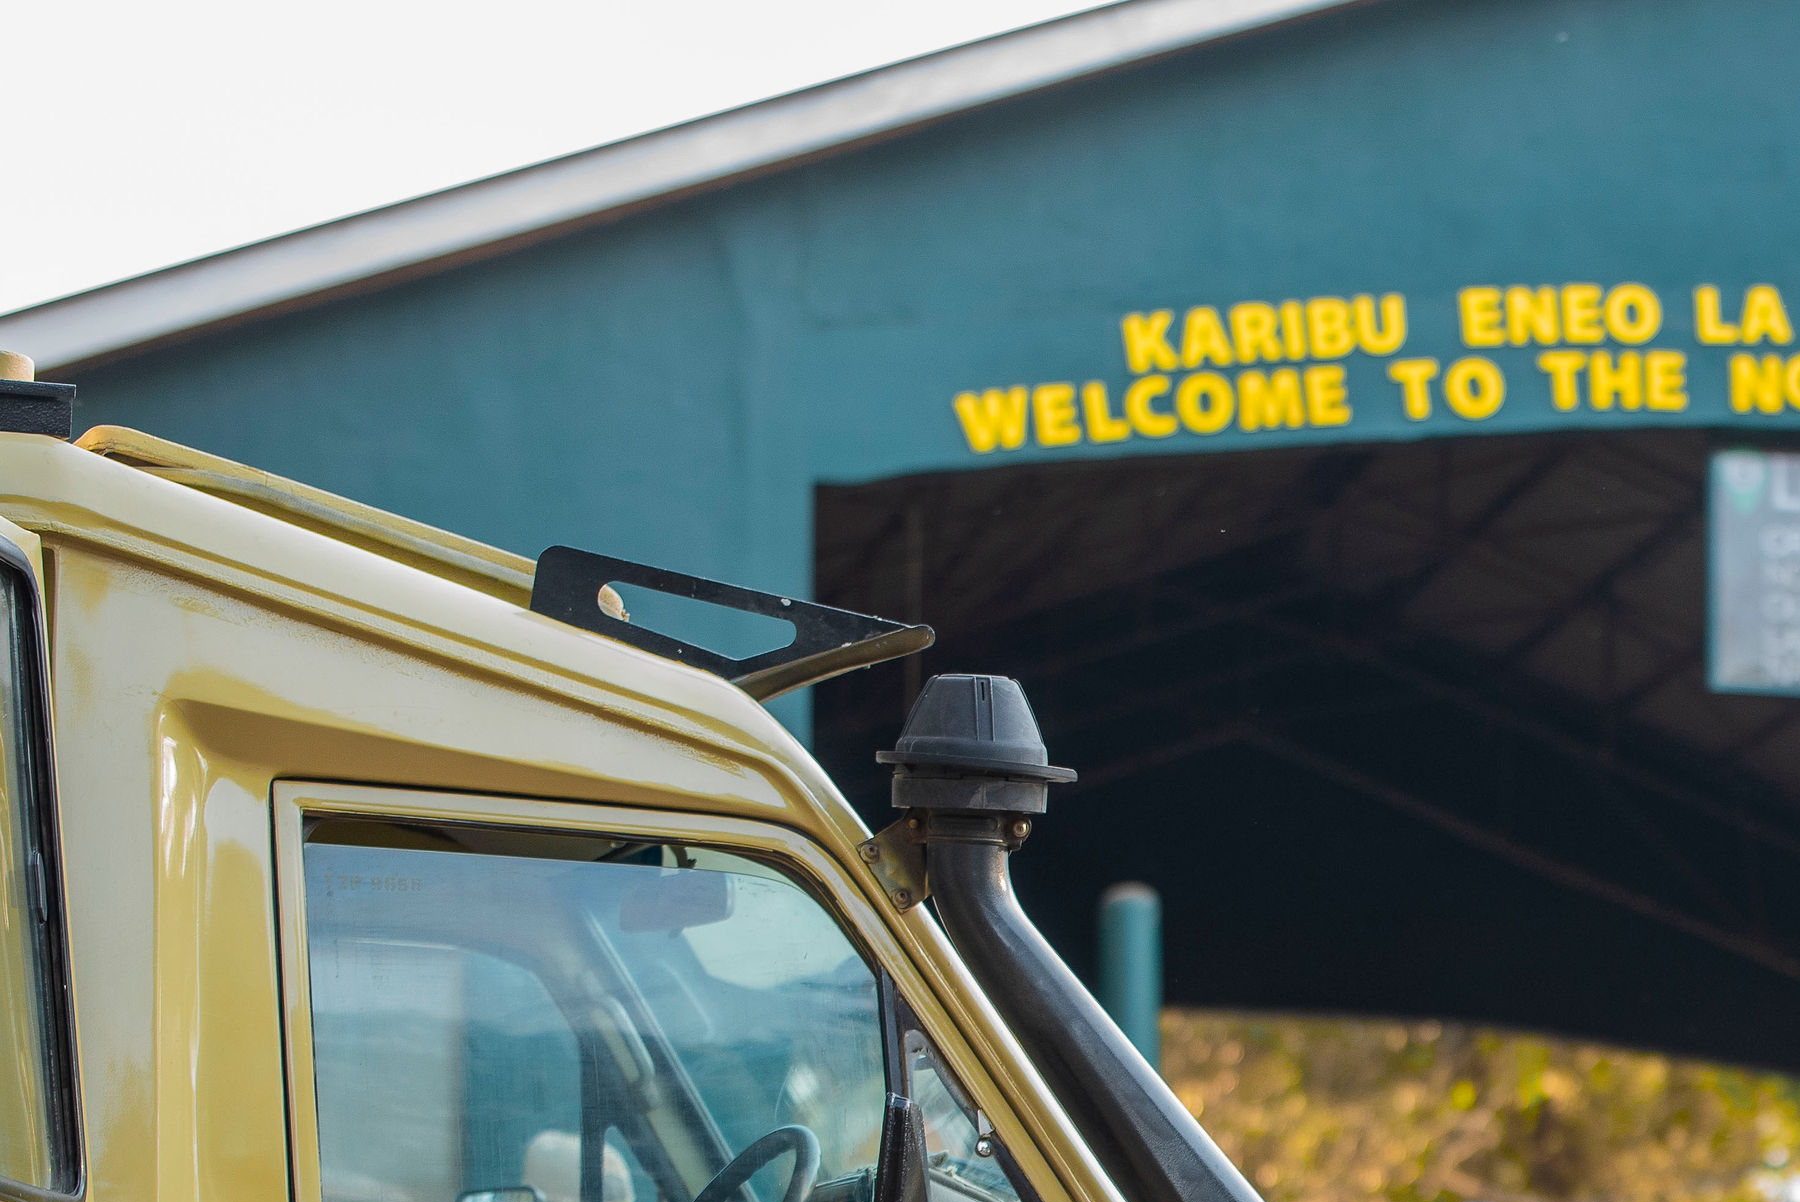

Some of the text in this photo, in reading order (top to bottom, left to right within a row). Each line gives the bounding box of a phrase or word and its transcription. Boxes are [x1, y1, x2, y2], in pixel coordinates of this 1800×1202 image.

[1123, 295, 1406, 374] KARIBU
[1459, 284, 1661, 347] ENEO
[1695, 285, 1793, 345] LA
[954, 366, 1350, 452] WELCOME
[1389, 357, 1505, 419] TO
[1538, 350, 1687, 412] THE
